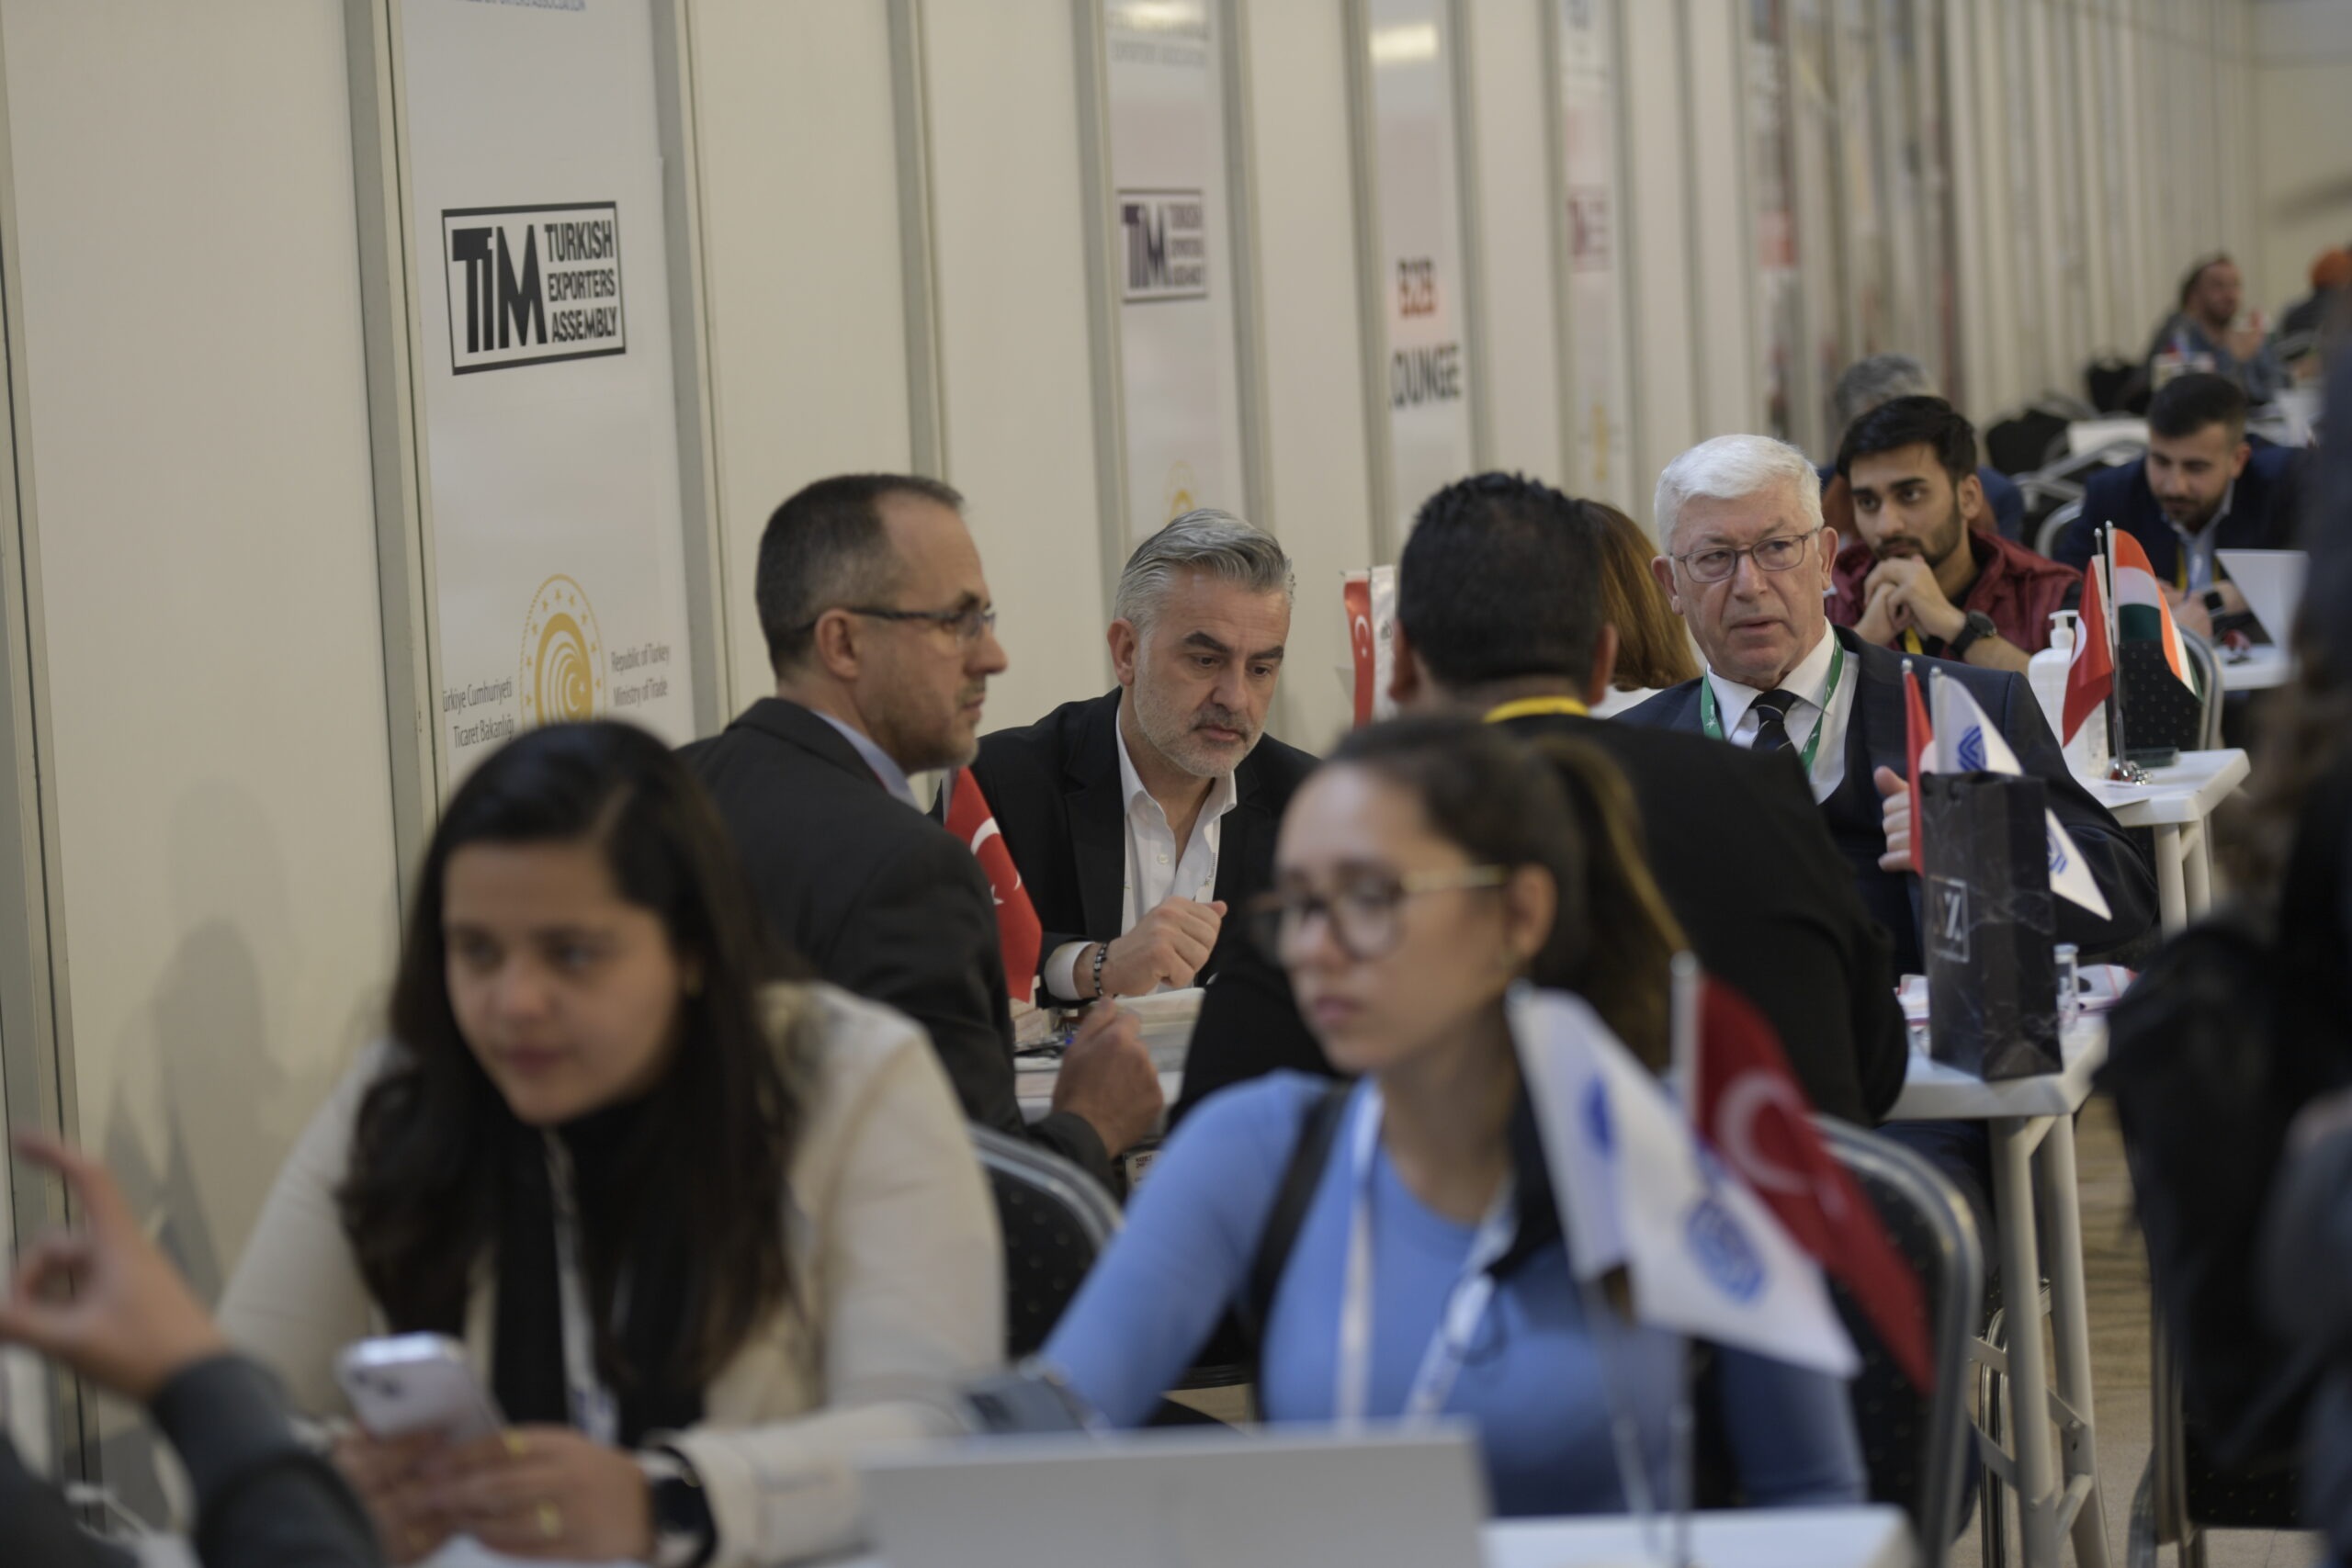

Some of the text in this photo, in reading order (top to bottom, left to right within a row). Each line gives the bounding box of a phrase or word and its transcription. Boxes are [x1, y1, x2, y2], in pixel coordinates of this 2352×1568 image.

[545, 220, 614, 262] TURKISH
[548, 268, 616, 301] EXPORTERS
[552, 307, 616, 343] ASSEMBLY
[1389, 343, 1461, 411] OUNGE
[610, 649, 640, 675] Republic
[648, 641, 670, 666] Turkey
[442, 678, 513, 715] ürkiye Cumhuriyeti
[612, 684, 641, 709] Ministry
[648, 677, 669, 698] Trade
[453, 721, 480, 750] Ticaret
